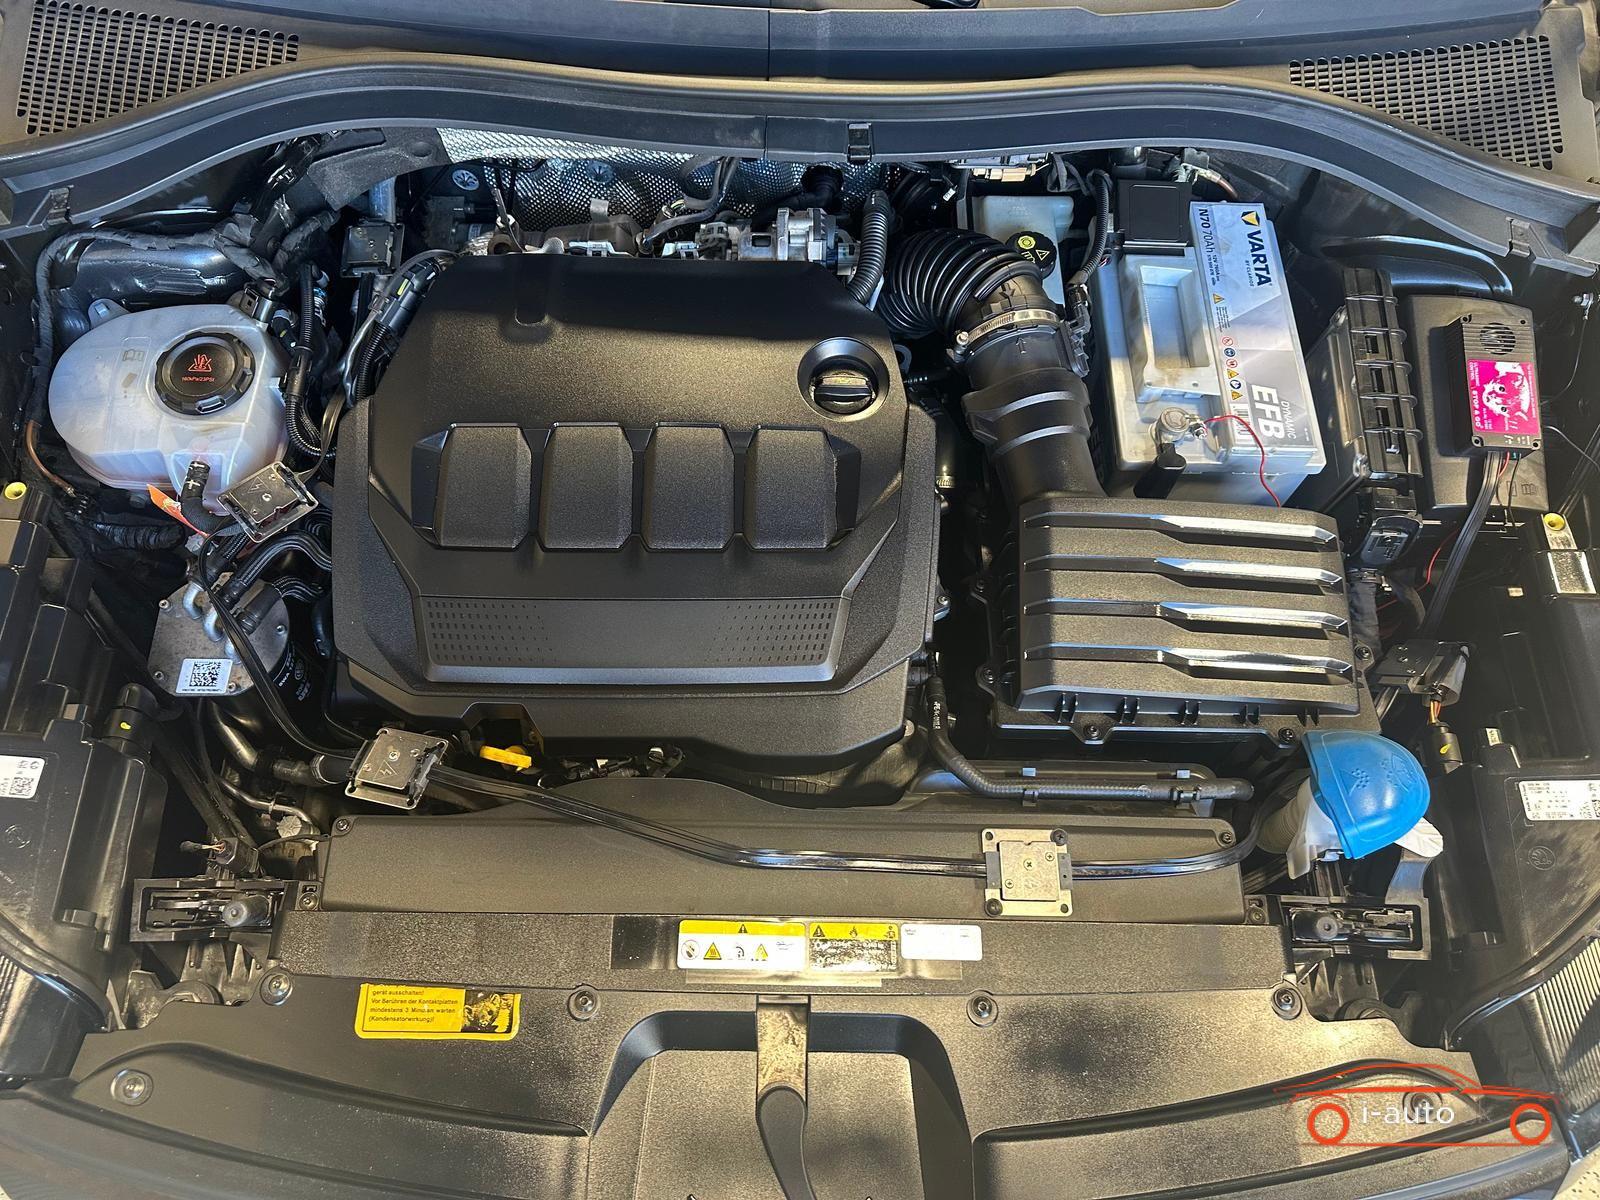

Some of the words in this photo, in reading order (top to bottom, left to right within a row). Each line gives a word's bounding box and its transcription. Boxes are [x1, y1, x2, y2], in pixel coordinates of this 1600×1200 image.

[1198, 208, 1211, 229] N70
[1202, 229, 1215, 253] 70Ah
[1246, 230, 1272, 287] VARTA
[1252, 384, 1285, 439] EFB
[1280, 400, 1296, 439] DYNAMIC
